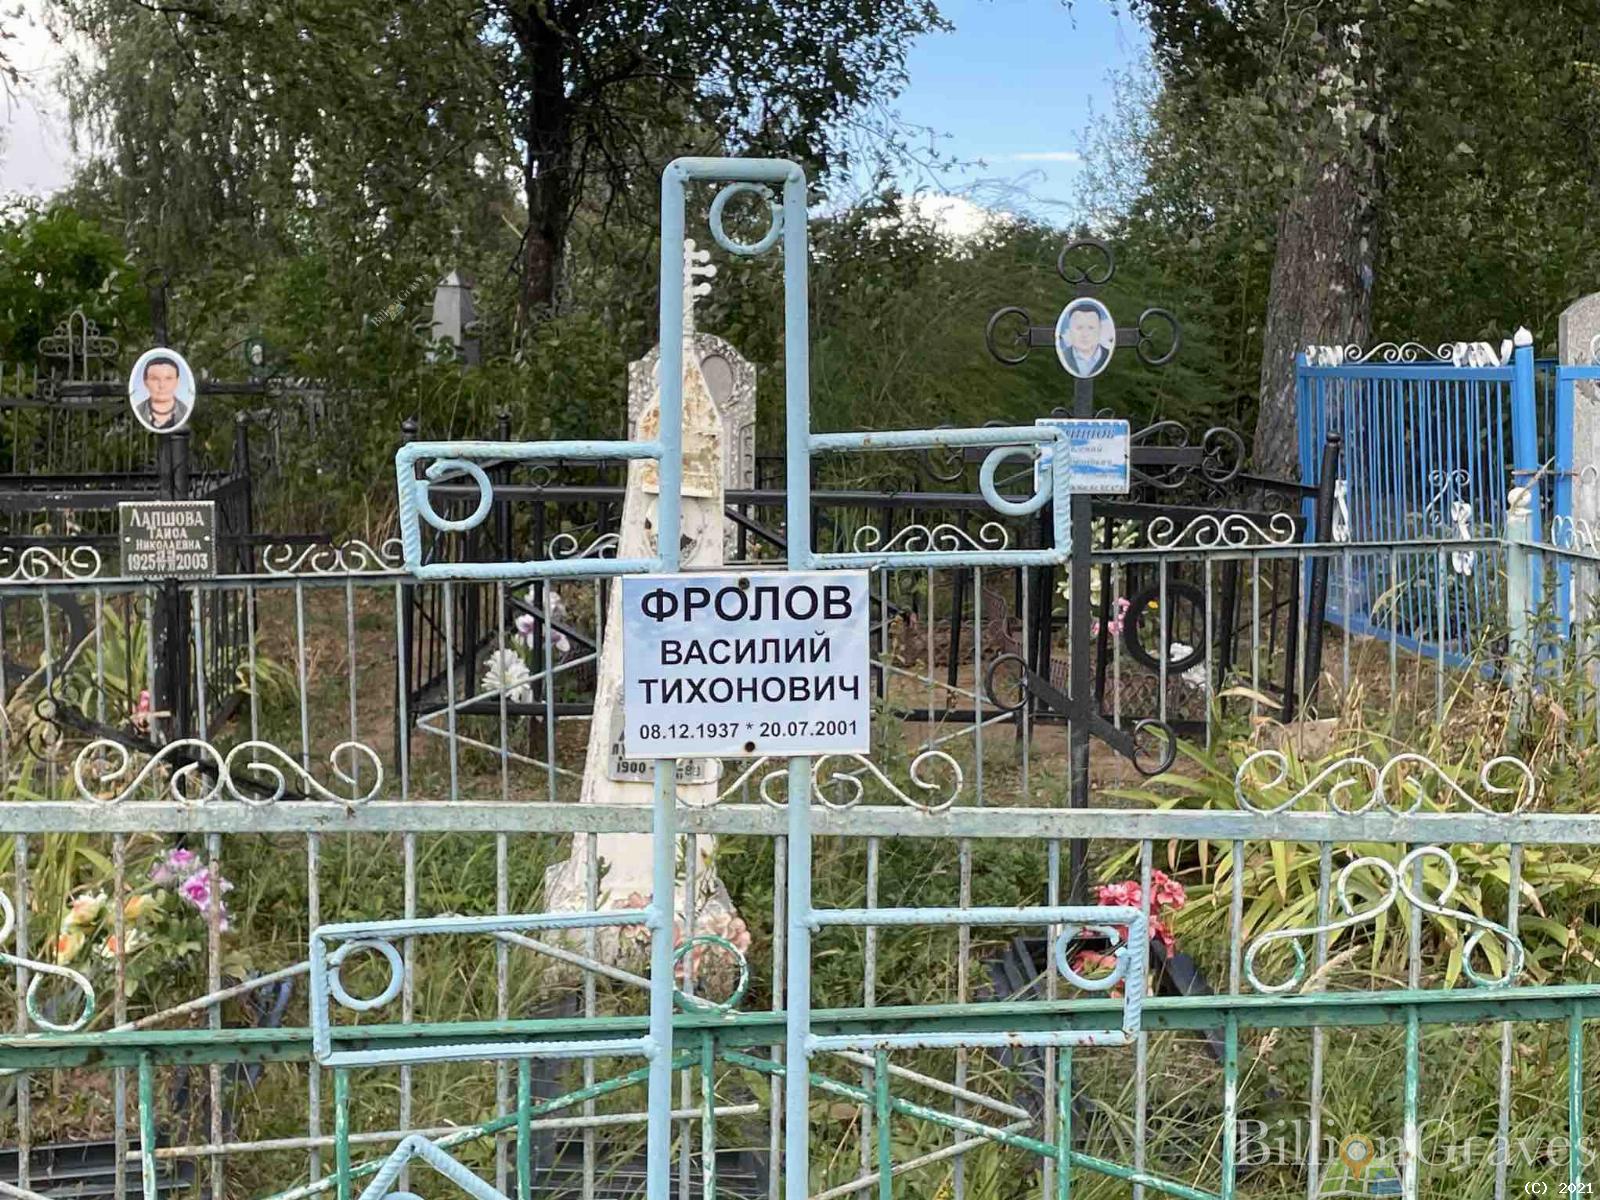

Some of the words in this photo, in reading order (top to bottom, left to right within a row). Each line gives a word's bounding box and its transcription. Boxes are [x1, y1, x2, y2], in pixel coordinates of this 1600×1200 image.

[128, 553, 156, 571] 1925
[176, 552, 208, 571] 2003
[640, 585, 853, 622] ФРОЛОВ
[660, 629, 831, 665] ВАСИЛИЙ
[638, 675, 860, 704] ТИХОНОВИЧ
[639, 722, 740, 739] 08.12.1937
[759, 720, 858, 738] 20.07.2001
[616, 761, 647, 774] 1900
